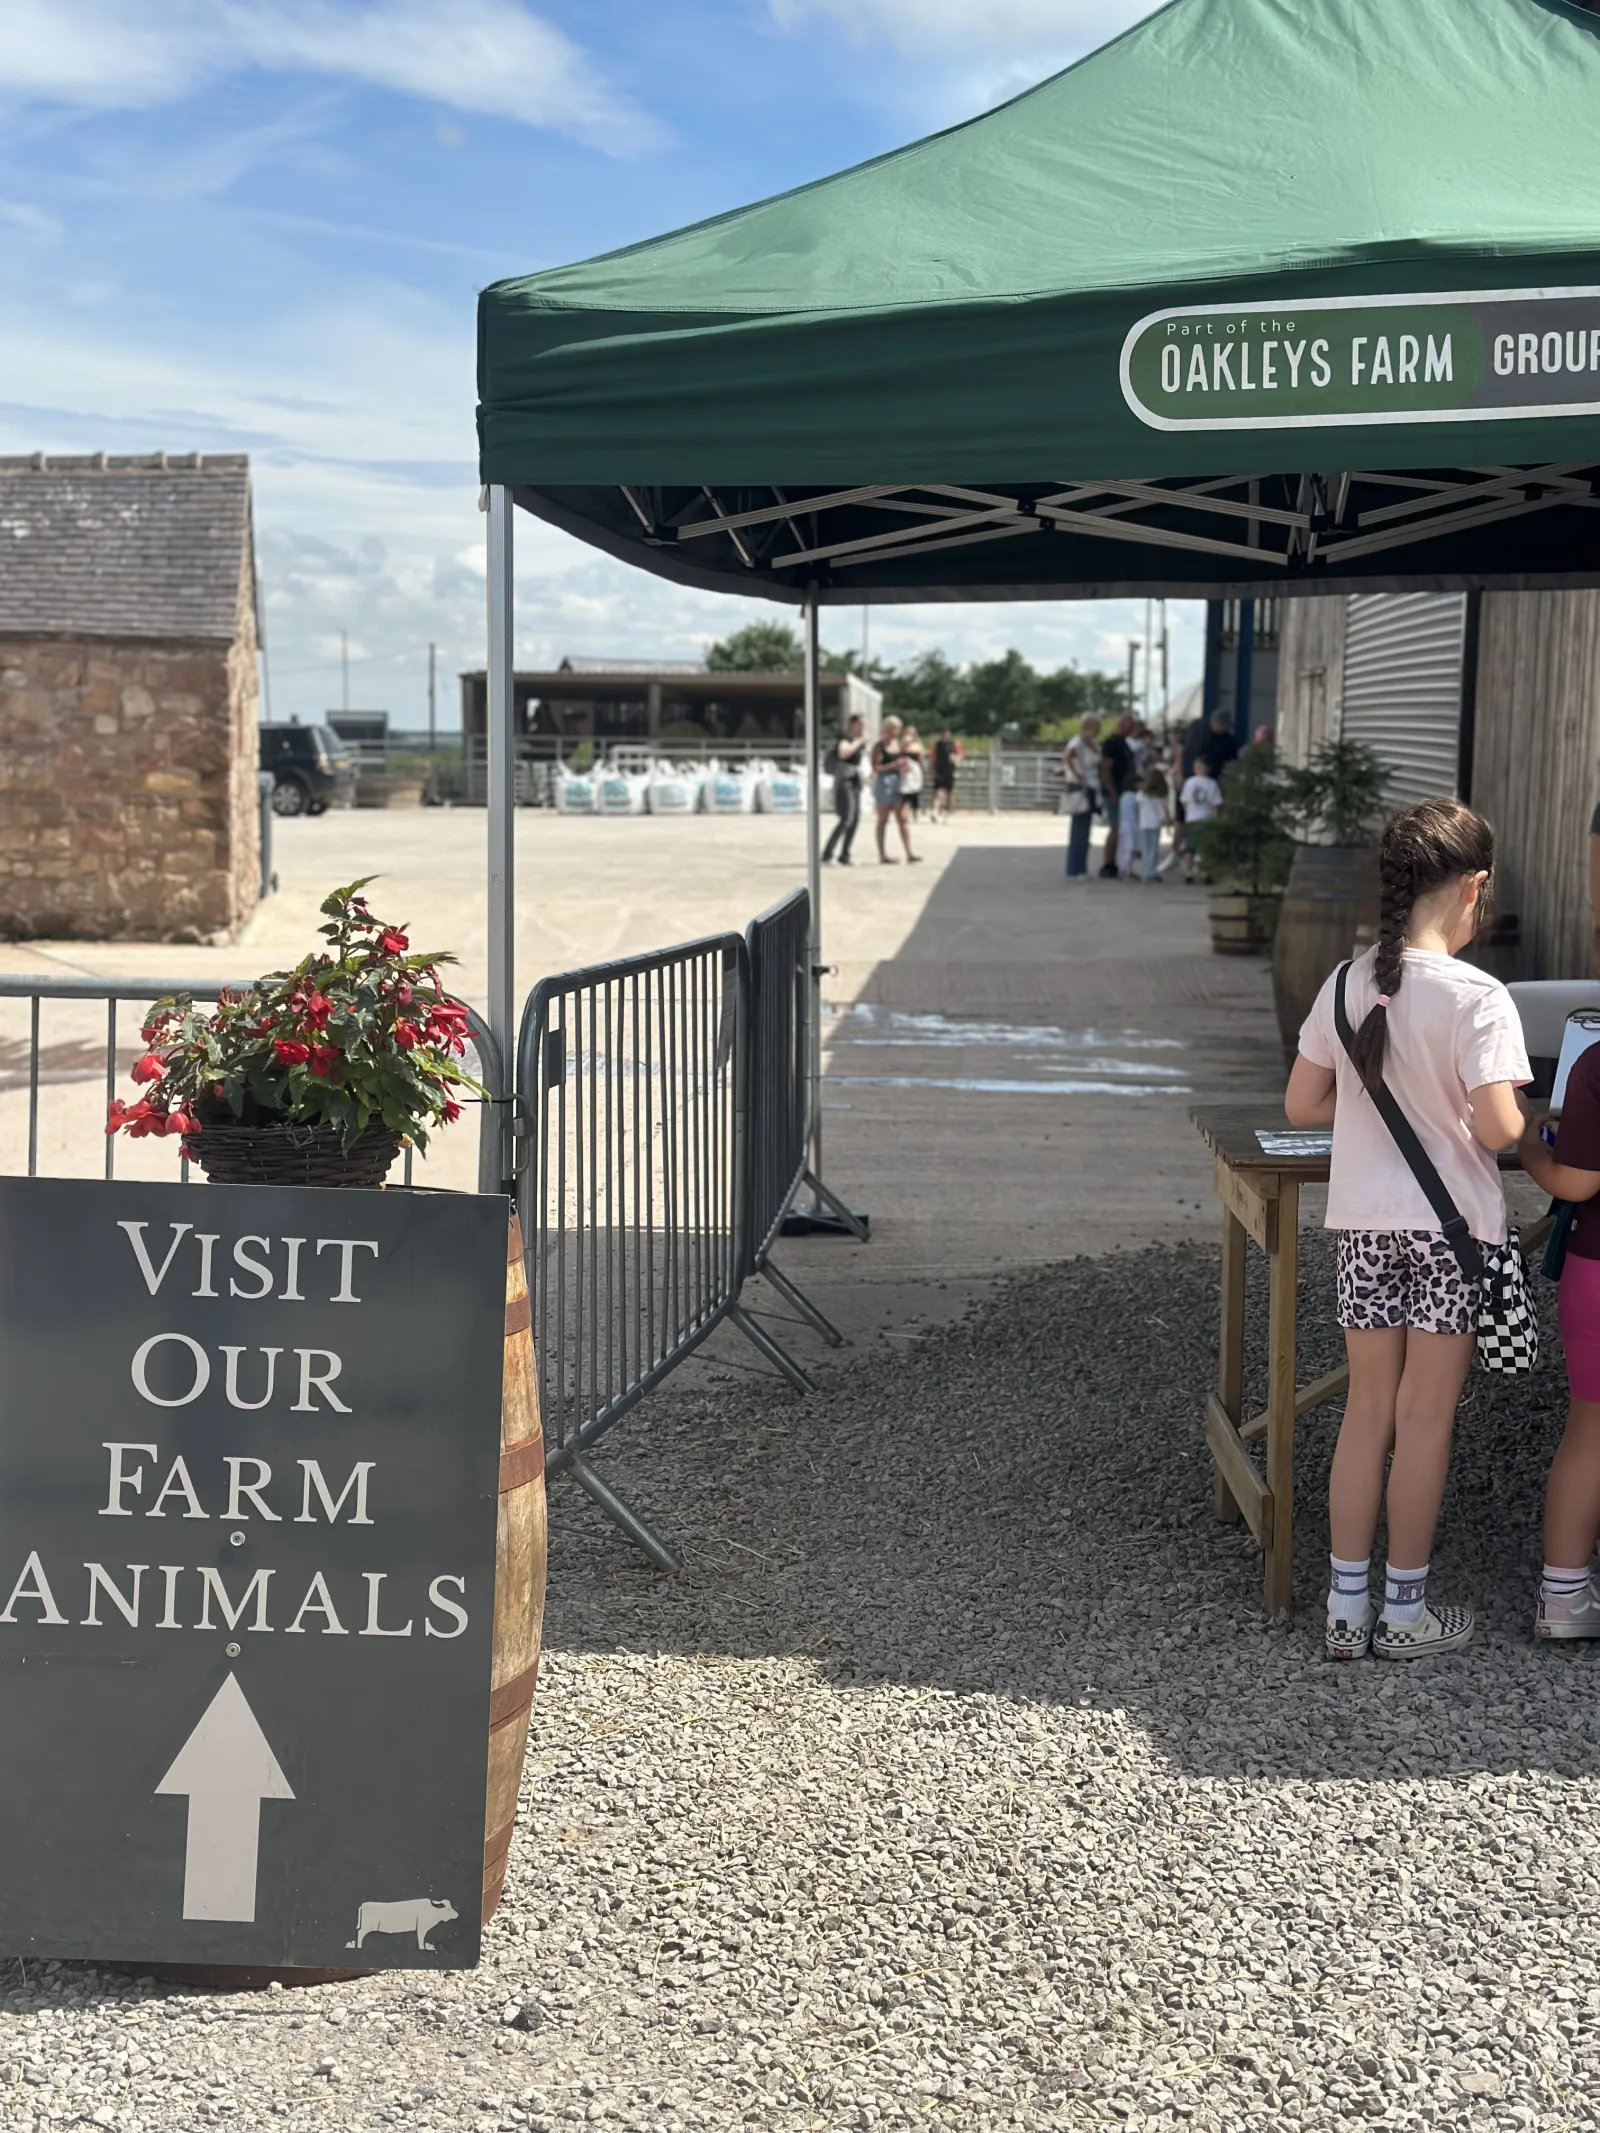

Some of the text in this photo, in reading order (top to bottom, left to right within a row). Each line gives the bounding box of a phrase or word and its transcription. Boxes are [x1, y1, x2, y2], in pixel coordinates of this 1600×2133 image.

[1161, 338, 1331, 393] OAKLEYS
[1351, 333, 1453, 386] FARM
[1167, 319, 1296, 336] Part of the
[117, 1220, 379, 1303] VISIT
[131, 1333, 353, 1413] OUR
[98, 1442, 376, 1525] FARM
[0, 1550, 469, 1639] ANIMALS
